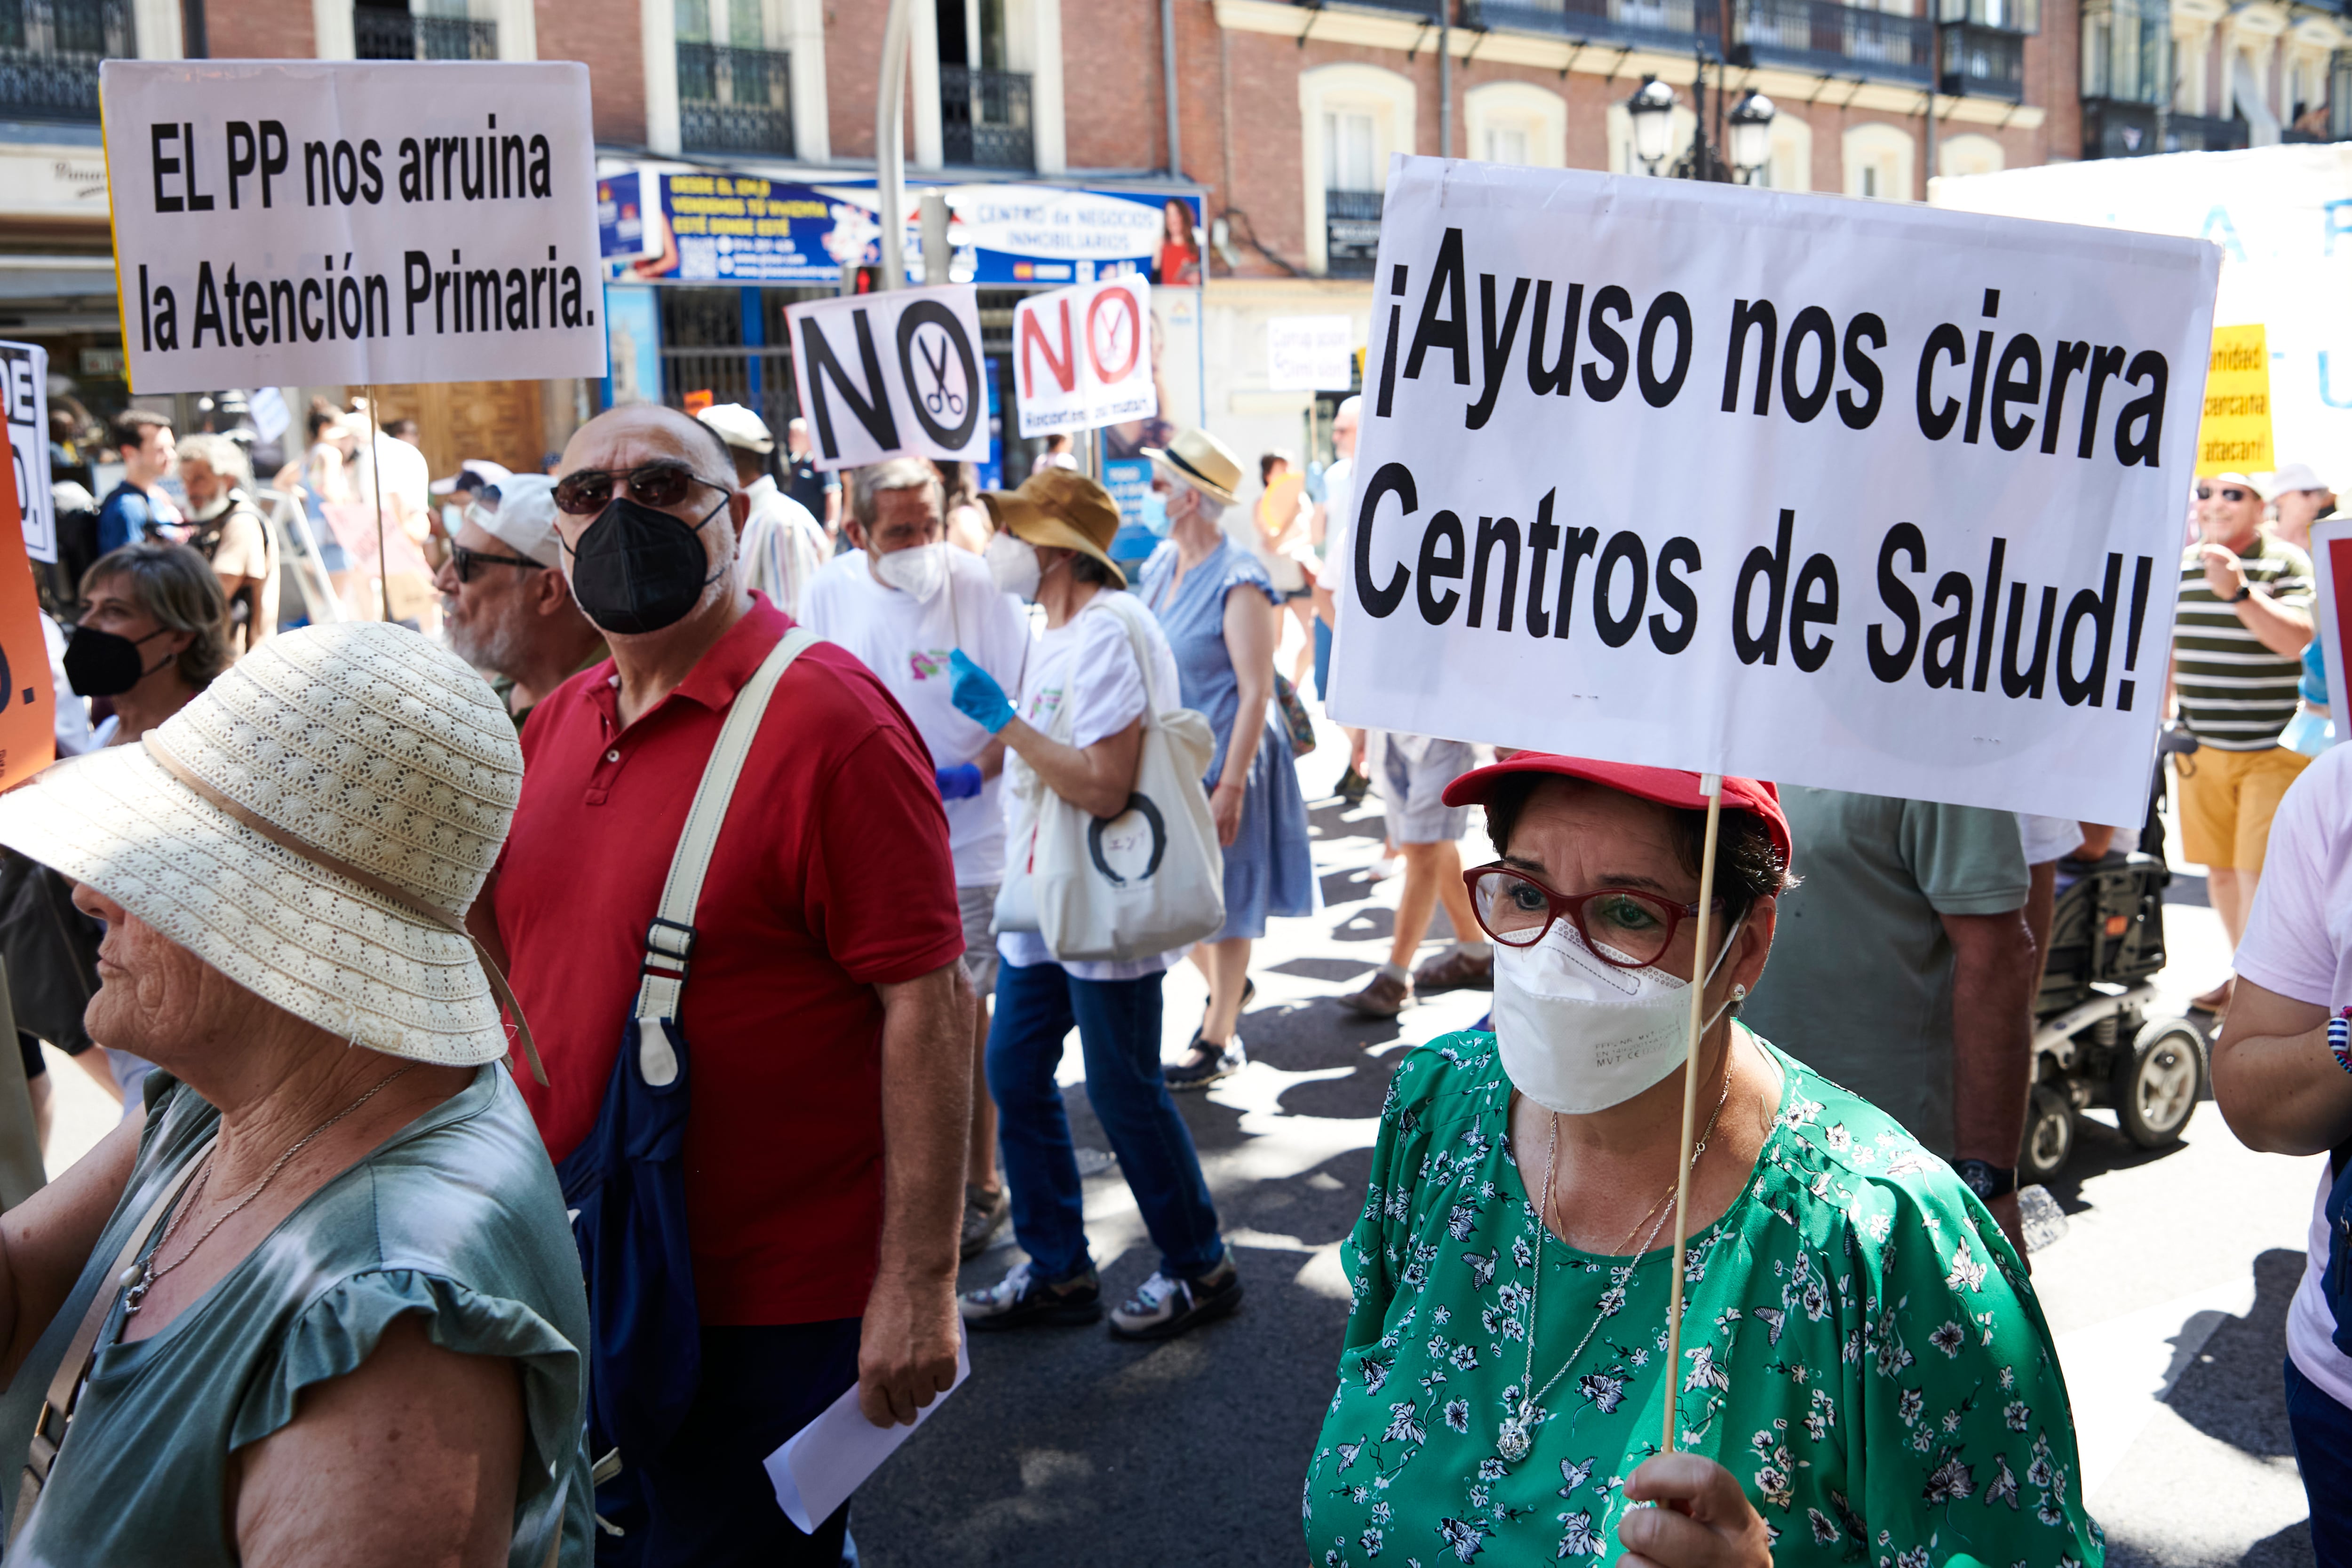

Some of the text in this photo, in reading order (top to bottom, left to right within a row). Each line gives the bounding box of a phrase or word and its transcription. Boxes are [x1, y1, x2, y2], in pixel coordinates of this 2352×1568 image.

[151, 113, 552, 213] EL PP nos arruina
[977, 203, 1045, 224] CENTRO
[1077, 208, 1154, 228] NEGOCIOS
[1009, 230, 1130, 251] INMOBILIARIOS
[139, 245, 595, 352] la Atención Primaria.
[1022, 287, 1141, 399] NO
[1376, 227, 2169, 467] ¡Ayuso nos cierra
[799, 299, 980, 459] NO
[1354, 462, 2153, 712] Centros de Salud!
